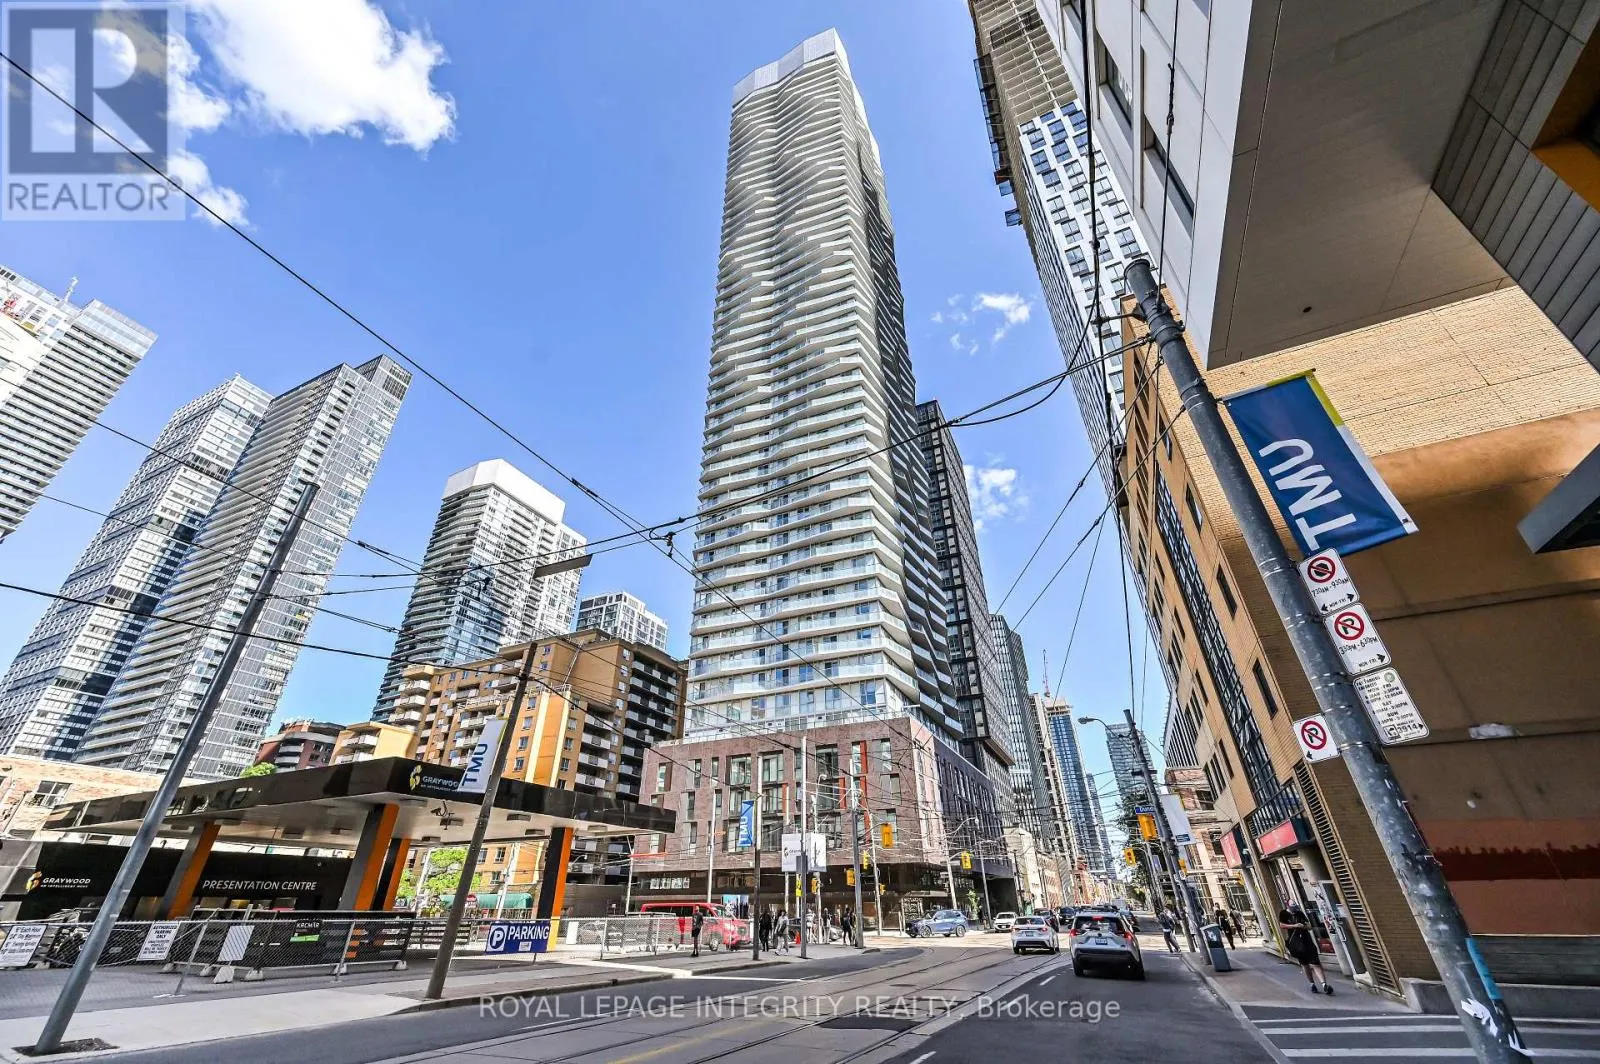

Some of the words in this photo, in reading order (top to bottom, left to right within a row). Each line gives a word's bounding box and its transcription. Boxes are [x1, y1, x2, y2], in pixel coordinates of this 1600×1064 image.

[1258, 439, 1357, 551] TMU
[462, 744, 488, 786] TMU
[422, 776, 460, 788] GRAYWOO
[739, 816, 749, 844] TMU
[202, 880, 279, 890] PRESENTATION
[281, 882, 318, 891] CENTRE
[508, 926, 550, 940] PARKING
